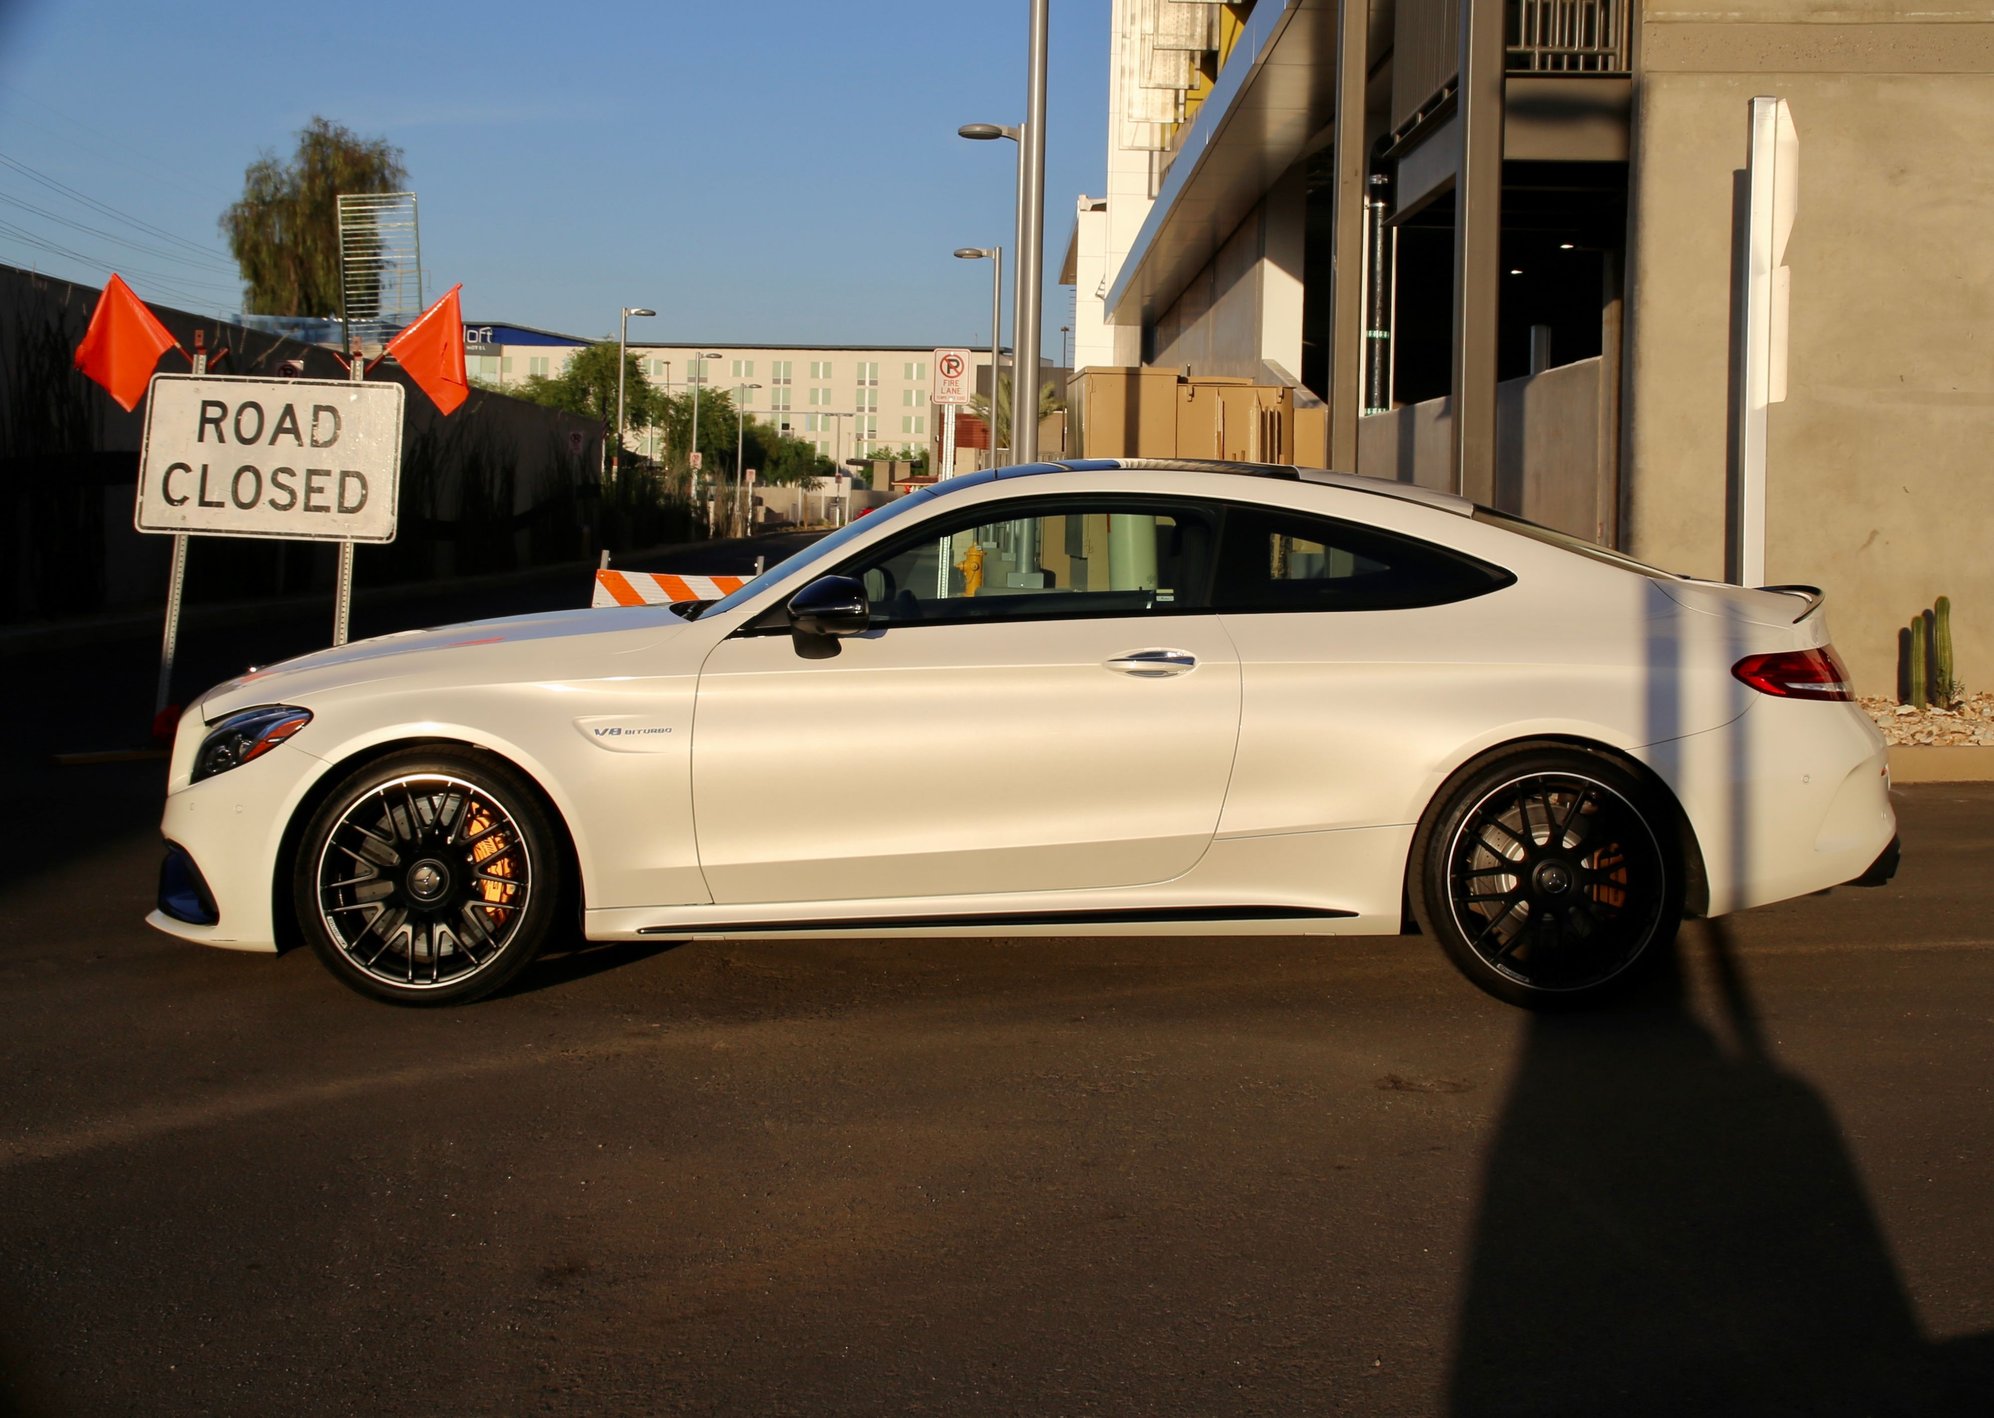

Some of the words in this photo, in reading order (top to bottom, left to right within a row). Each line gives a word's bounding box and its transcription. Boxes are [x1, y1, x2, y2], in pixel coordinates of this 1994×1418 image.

[463, 325, 493, 344] loft
[943, 379, 960, 387] FIRE
[941, 387, 961, 395] LANE
[197, 399, 342, 448] ROAD
[161, 461, 369, 515] CLOSED
[594, 727, 622, 737] V8
[624, 727, 673, 736] BITURBO
